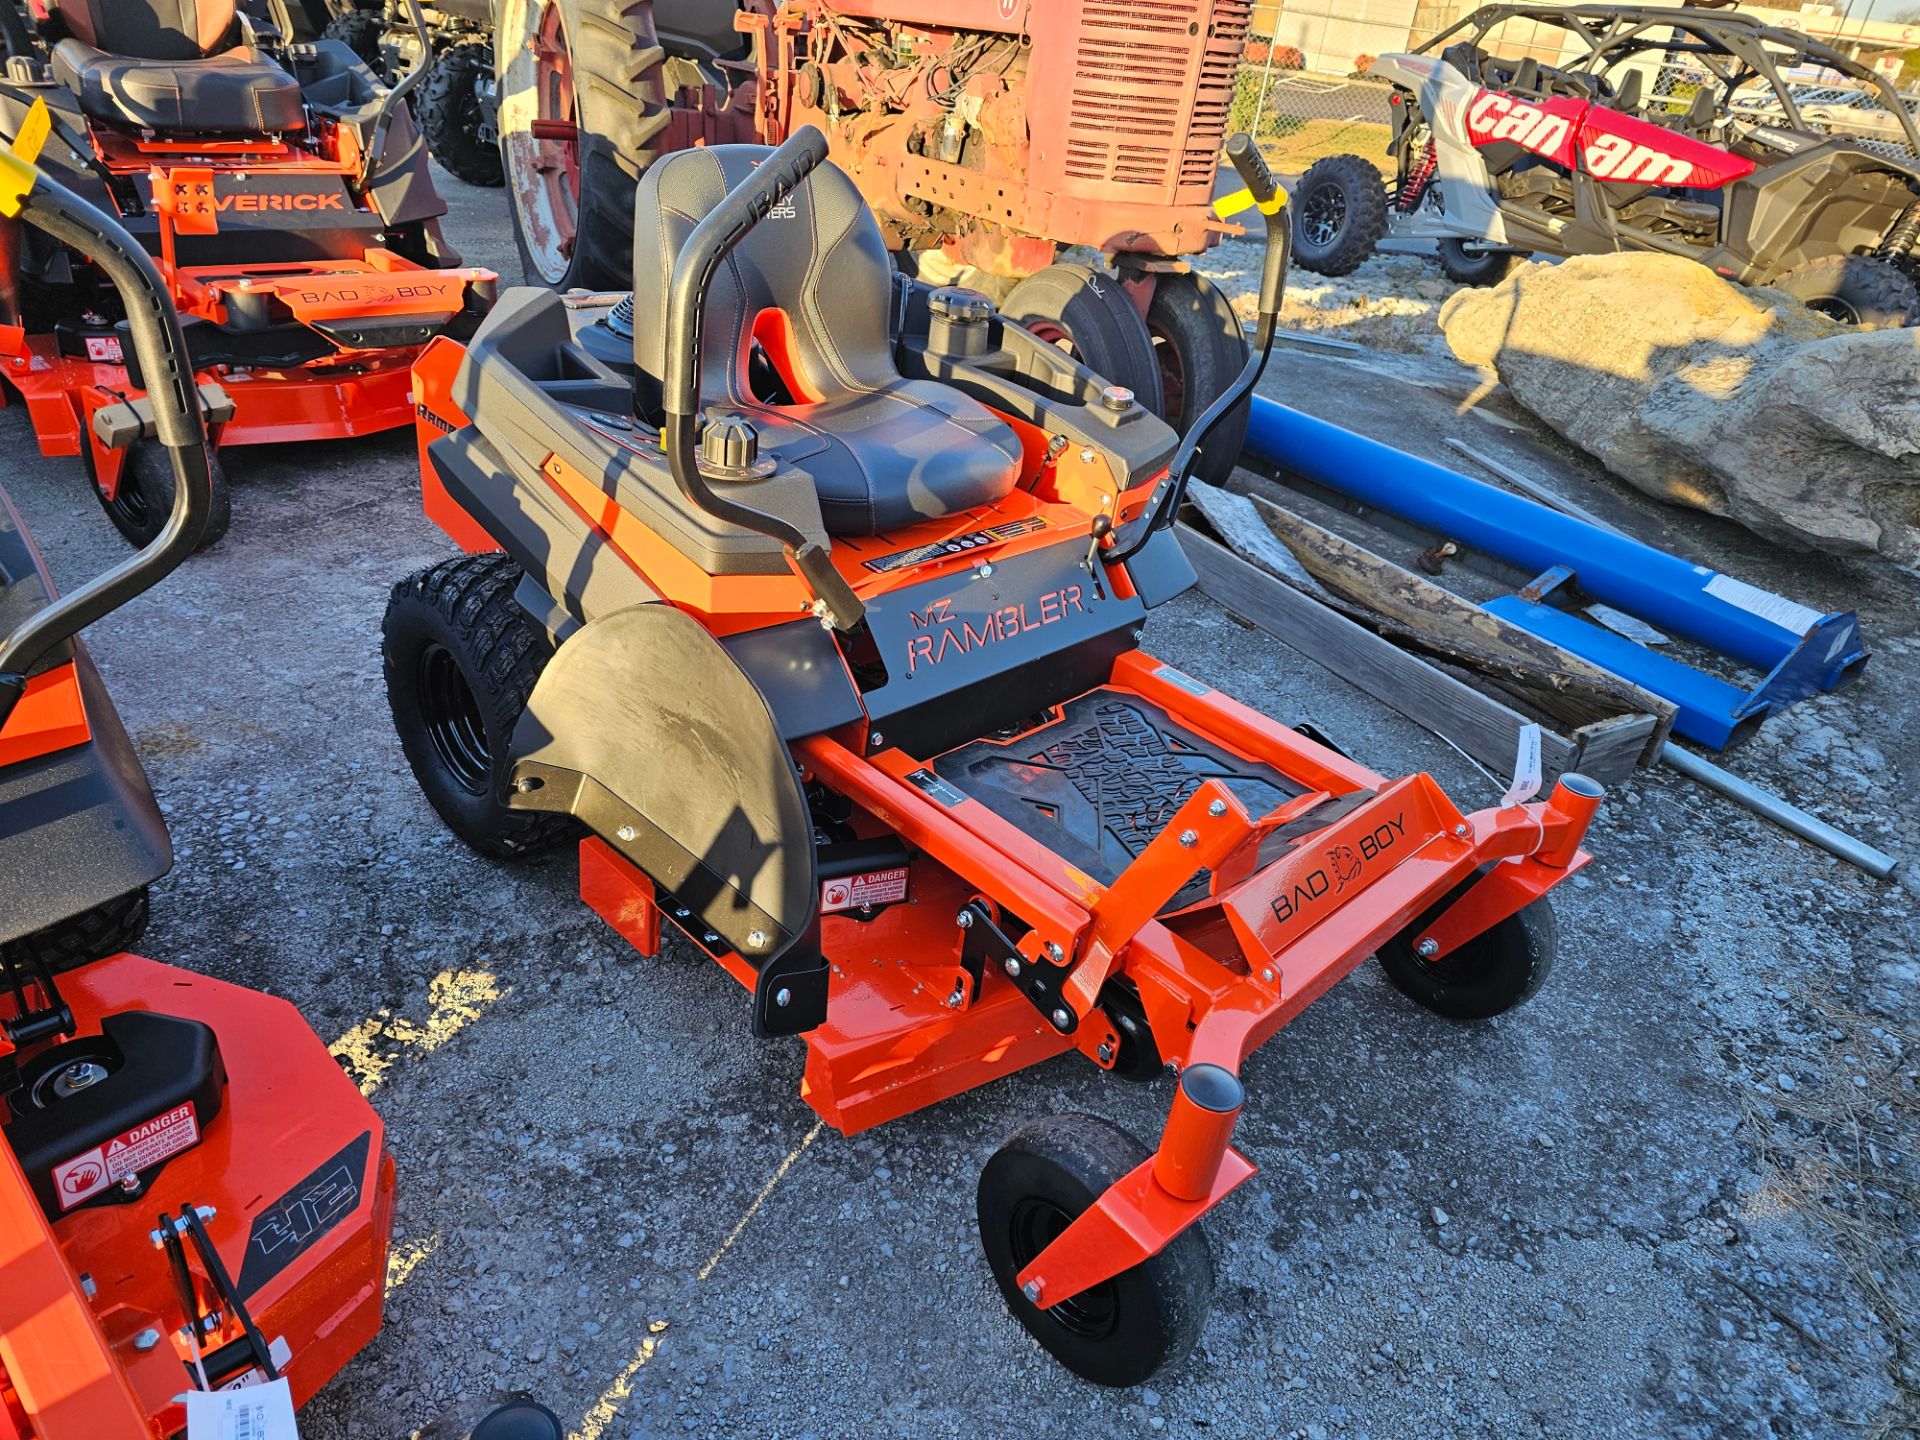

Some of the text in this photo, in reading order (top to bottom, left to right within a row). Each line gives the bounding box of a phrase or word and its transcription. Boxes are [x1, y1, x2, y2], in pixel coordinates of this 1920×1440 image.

[301, 284, 446, 304] BAD BOY
[907, 584, 1085, 673] RAMBLER
[909, 598, 957, 631] MZ
[868, 870, 905, 883] DANGER
[1270, 811, 1405, 924] BAD BOY
[129, 1106, 189, 1144] DANGER
[109, 1152, 125, 1164] KEEP
[128, 1141, 148, 1155] HANDS
[156, 1130, 171, 1142] FEET
[112, 1126, 191, 1169] DO NOT OPERATE MOWER
[139, 1147, 160, 1162] GUARD
[162, 1143, 171, 1151] OR
[172, 1131, 193, 1146] GRASS
[119, 1160, 148, 1178] CATCHER
[149, 1154, 156, 1162] IS
[252, 1164, 358, 1254] 42
